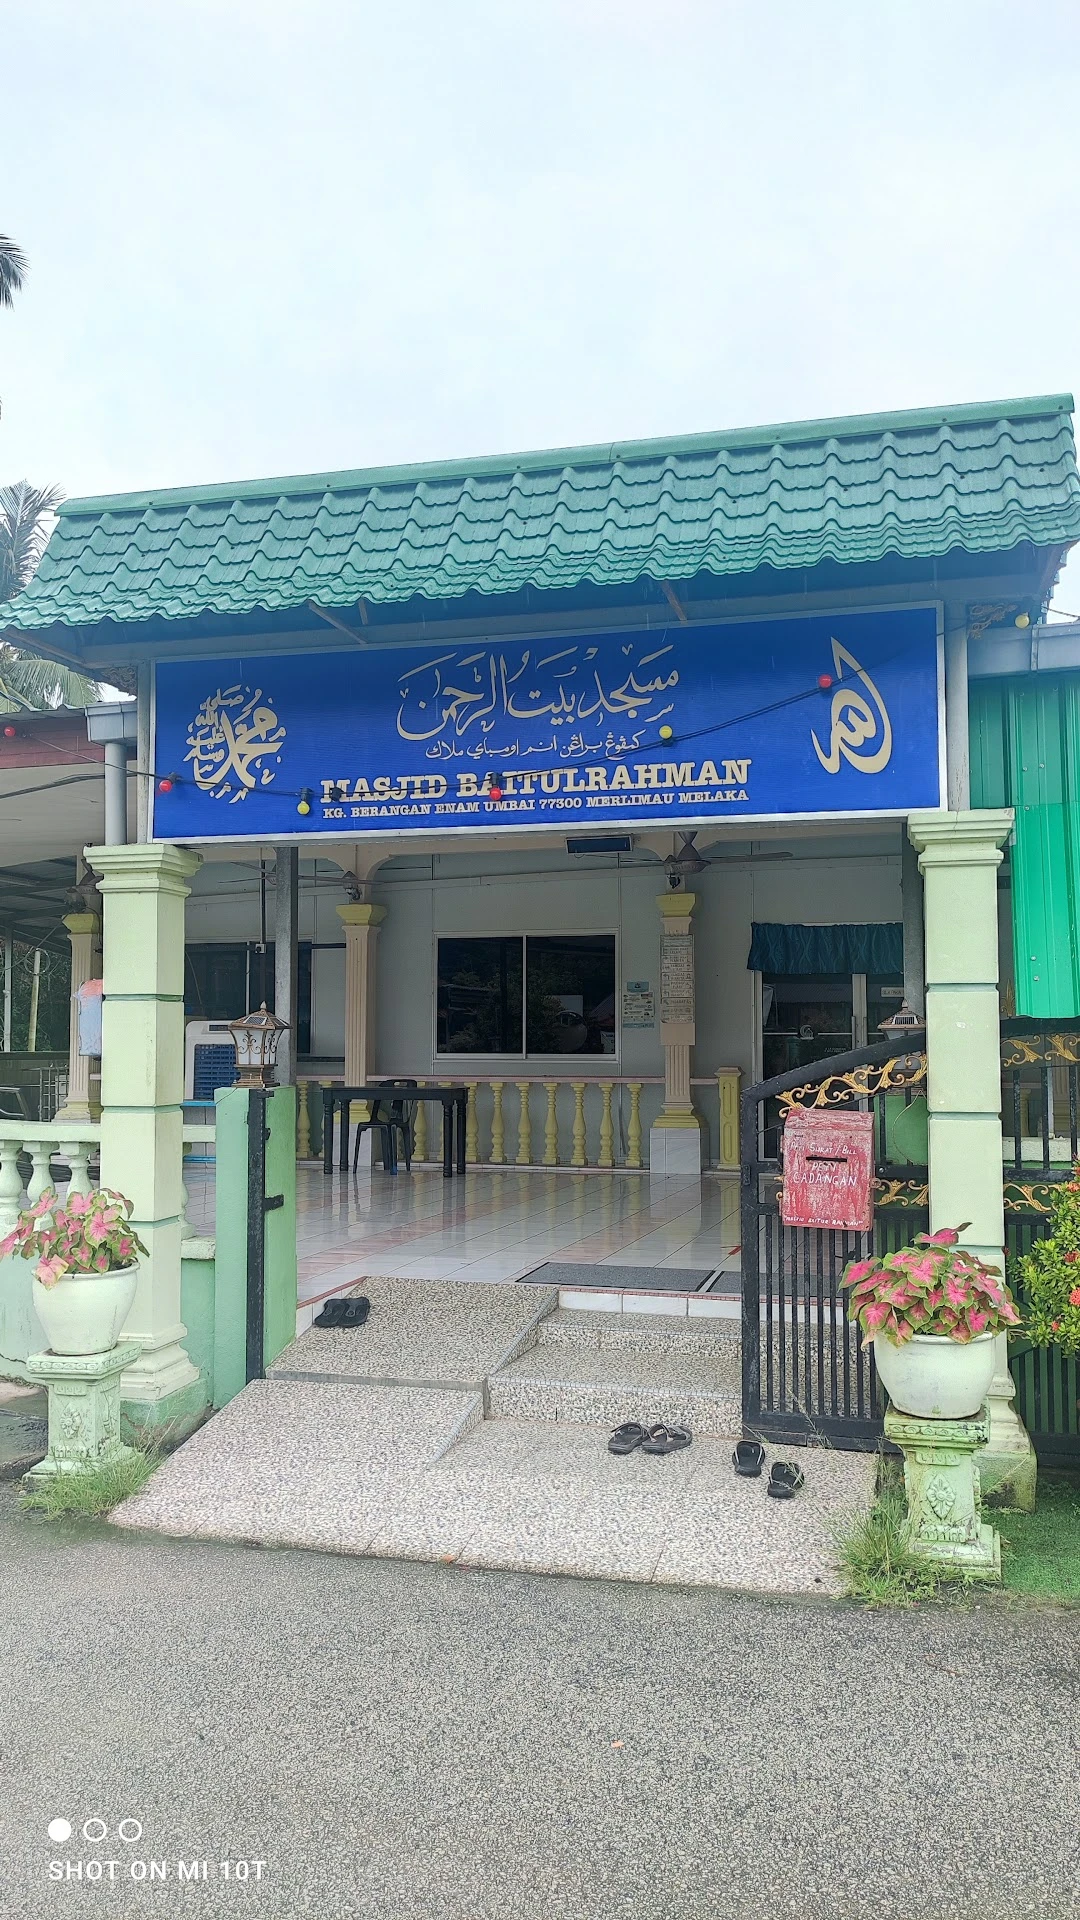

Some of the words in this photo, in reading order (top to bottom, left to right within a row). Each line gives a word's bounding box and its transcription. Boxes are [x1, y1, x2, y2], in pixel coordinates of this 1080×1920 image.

[320, 774, 448, 804] MASJID
[456, 759, 752, 798] BAITULRAHMAN
[323, 807, 347, 819] KG.
[351, 804, 431, 818] BERANGAN
[434, 802, 480, 815] ENAM
[484, 799, 536, 812] UMBAI
[539, 797, 582, 810] 77300
[586, 793, 675, 808] MERLIMAU
[678, 790, 750, 804] MELAKA
[793, 1171, 857, 1188] CADANGAN
